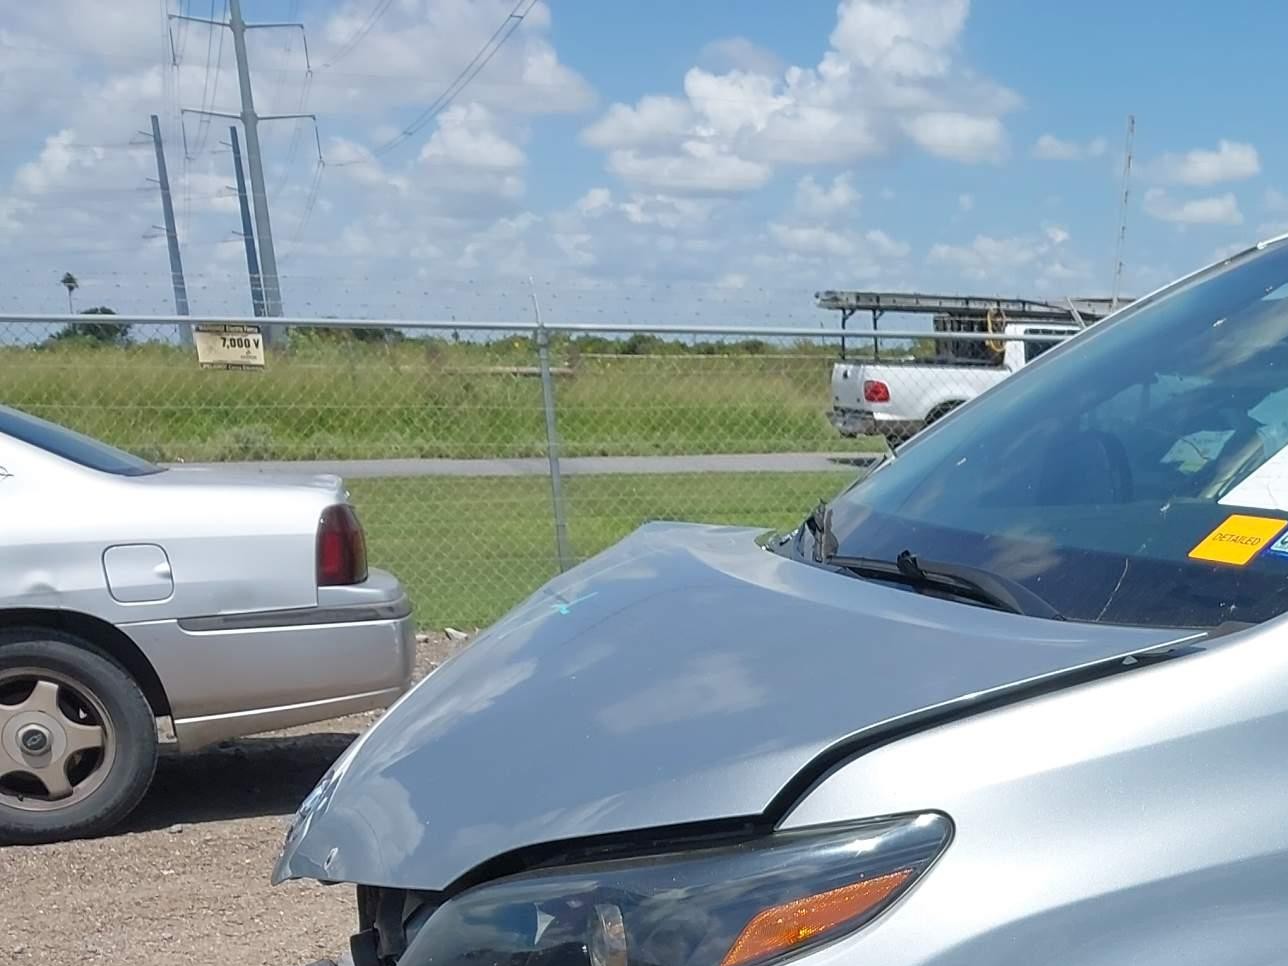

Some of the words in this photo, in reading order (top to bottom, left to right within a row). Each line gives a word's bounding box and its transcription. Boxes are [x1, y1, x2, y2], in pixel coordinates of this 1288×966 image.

[221, 336, 251, 349] 7,000
[253, 338, 260, 349] V
[1212, 532, 1262, 546] DETAILED
